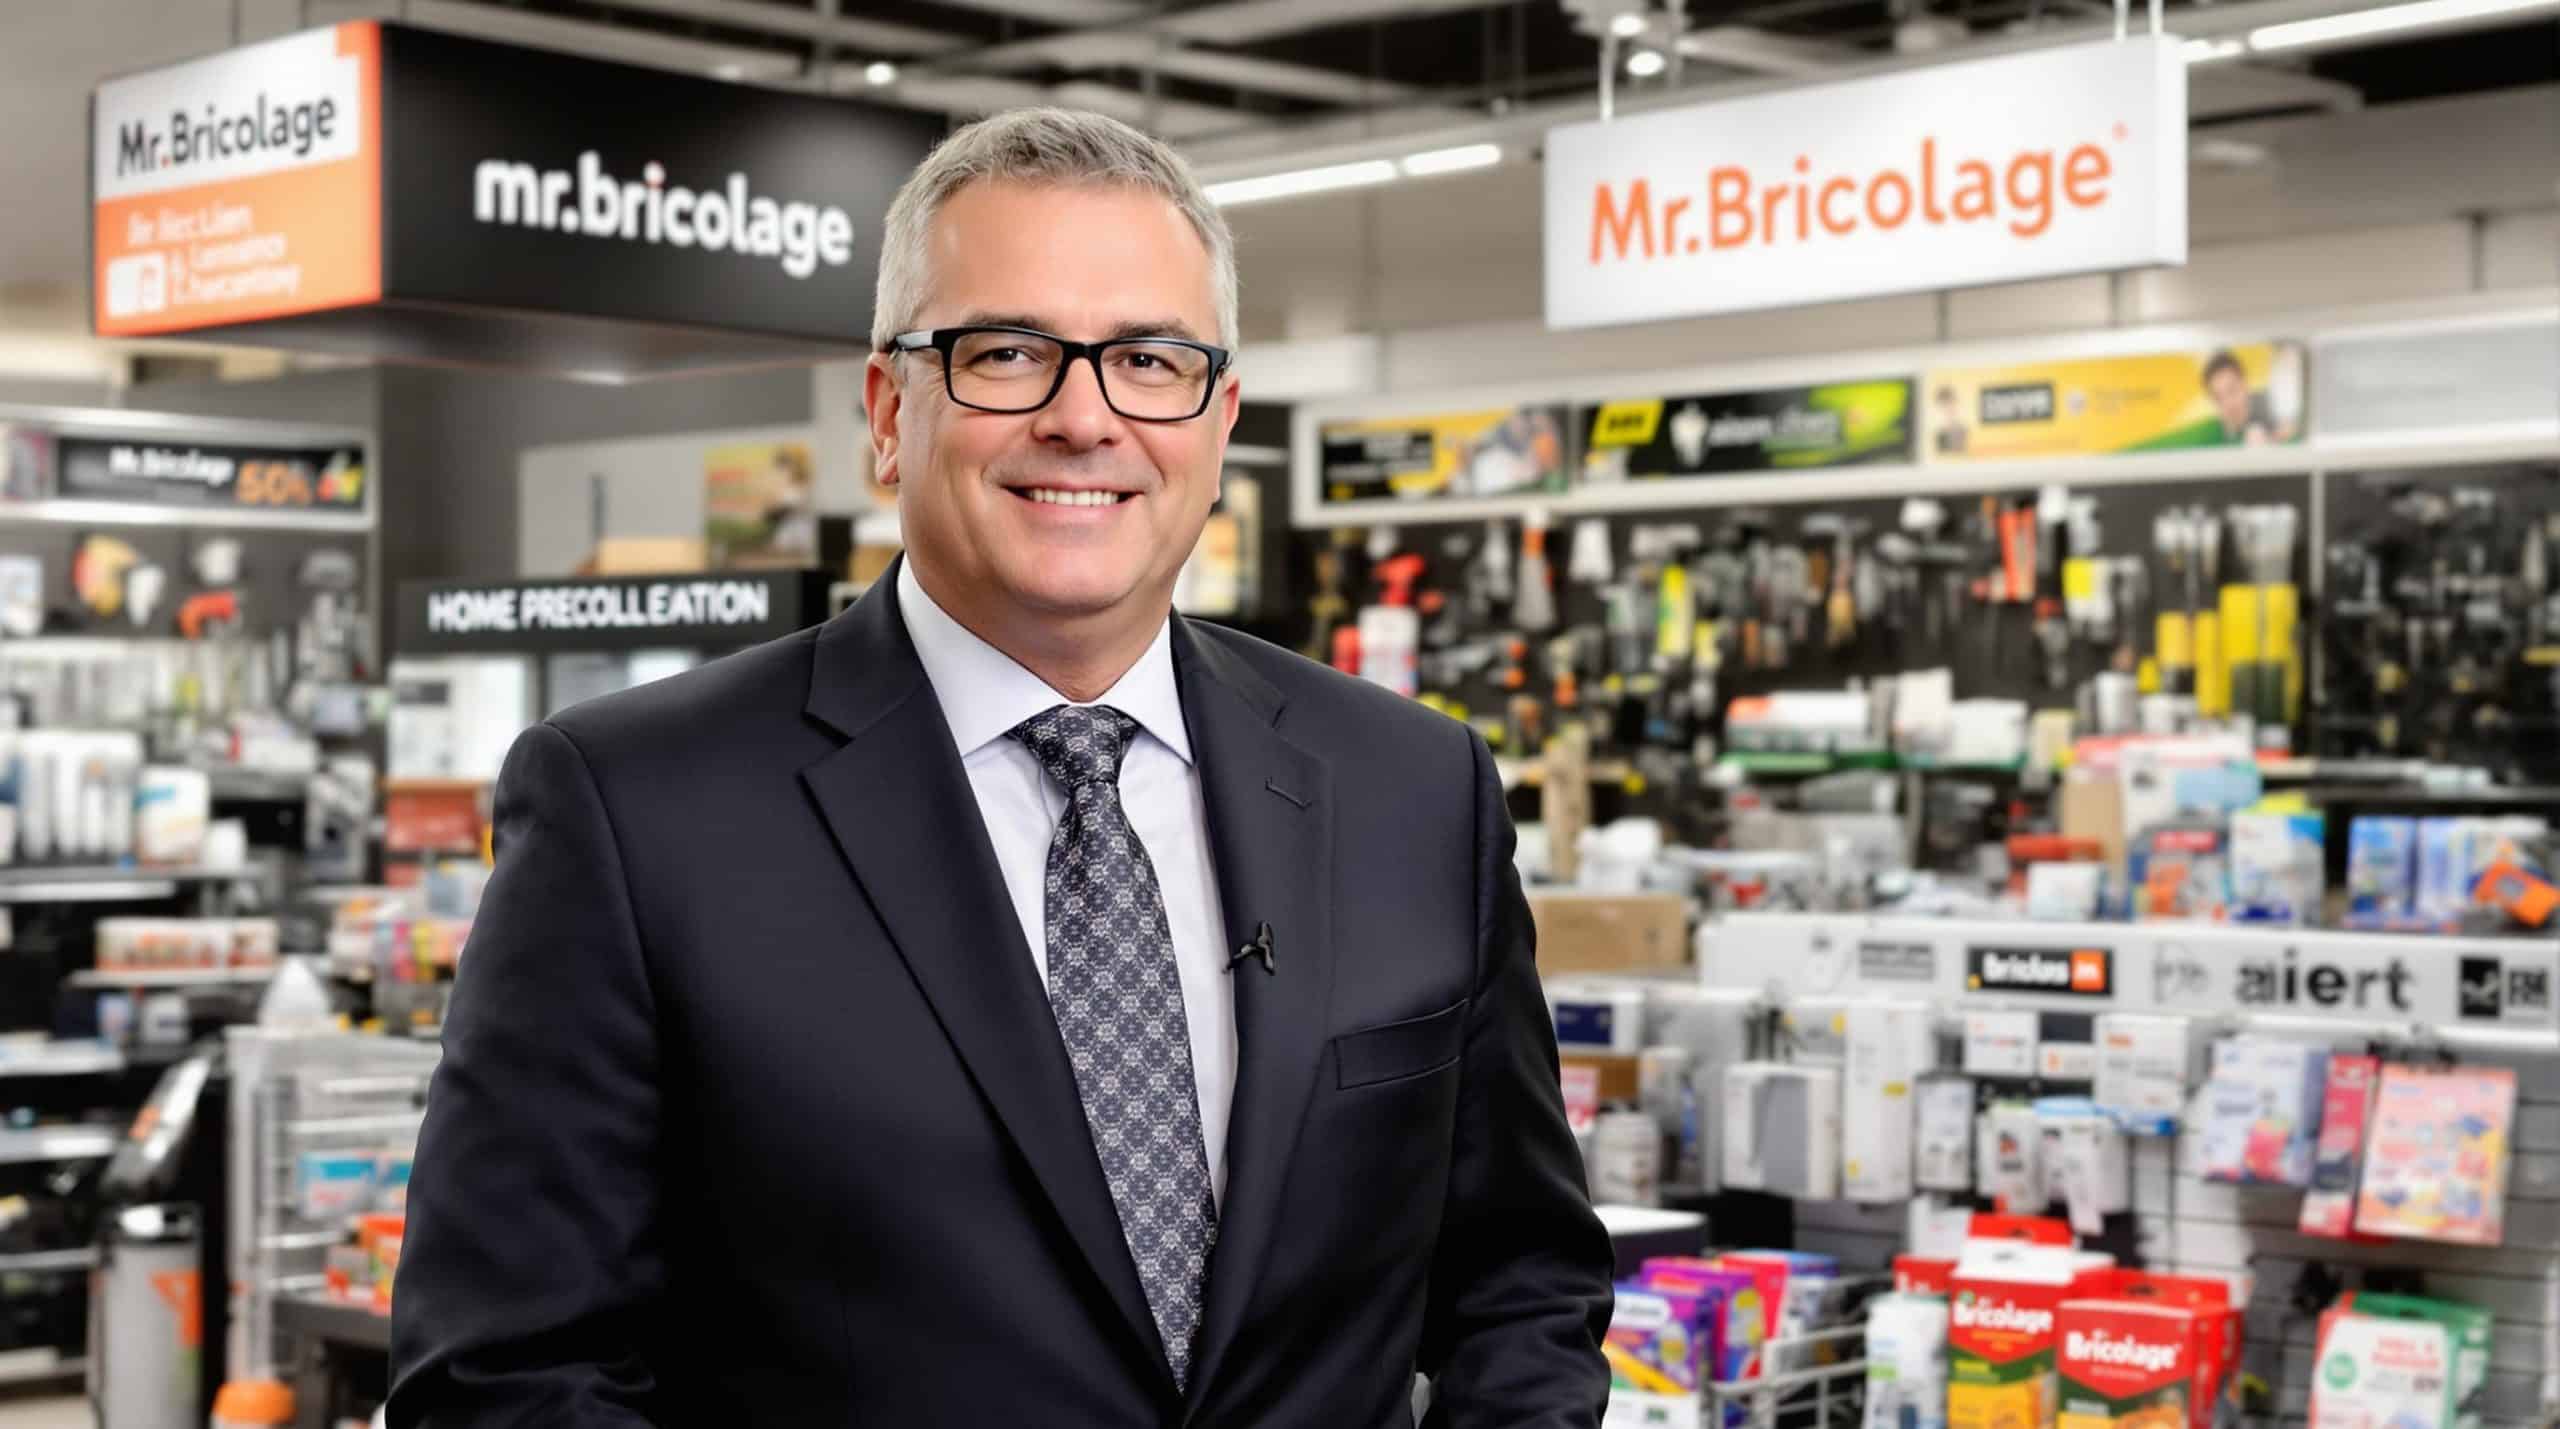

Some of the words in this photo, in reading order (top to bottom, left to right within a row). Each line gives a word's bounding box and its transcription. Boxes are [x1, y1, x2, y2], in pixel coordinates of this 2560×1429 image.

[116, 91, 338, 178] Mr.Bricolage
[473, 151, 856, 279] mr.bricolage
[1590, 136, 2112, 265] Mr.Bricolage
[428, 588, 519, 632] HOME
